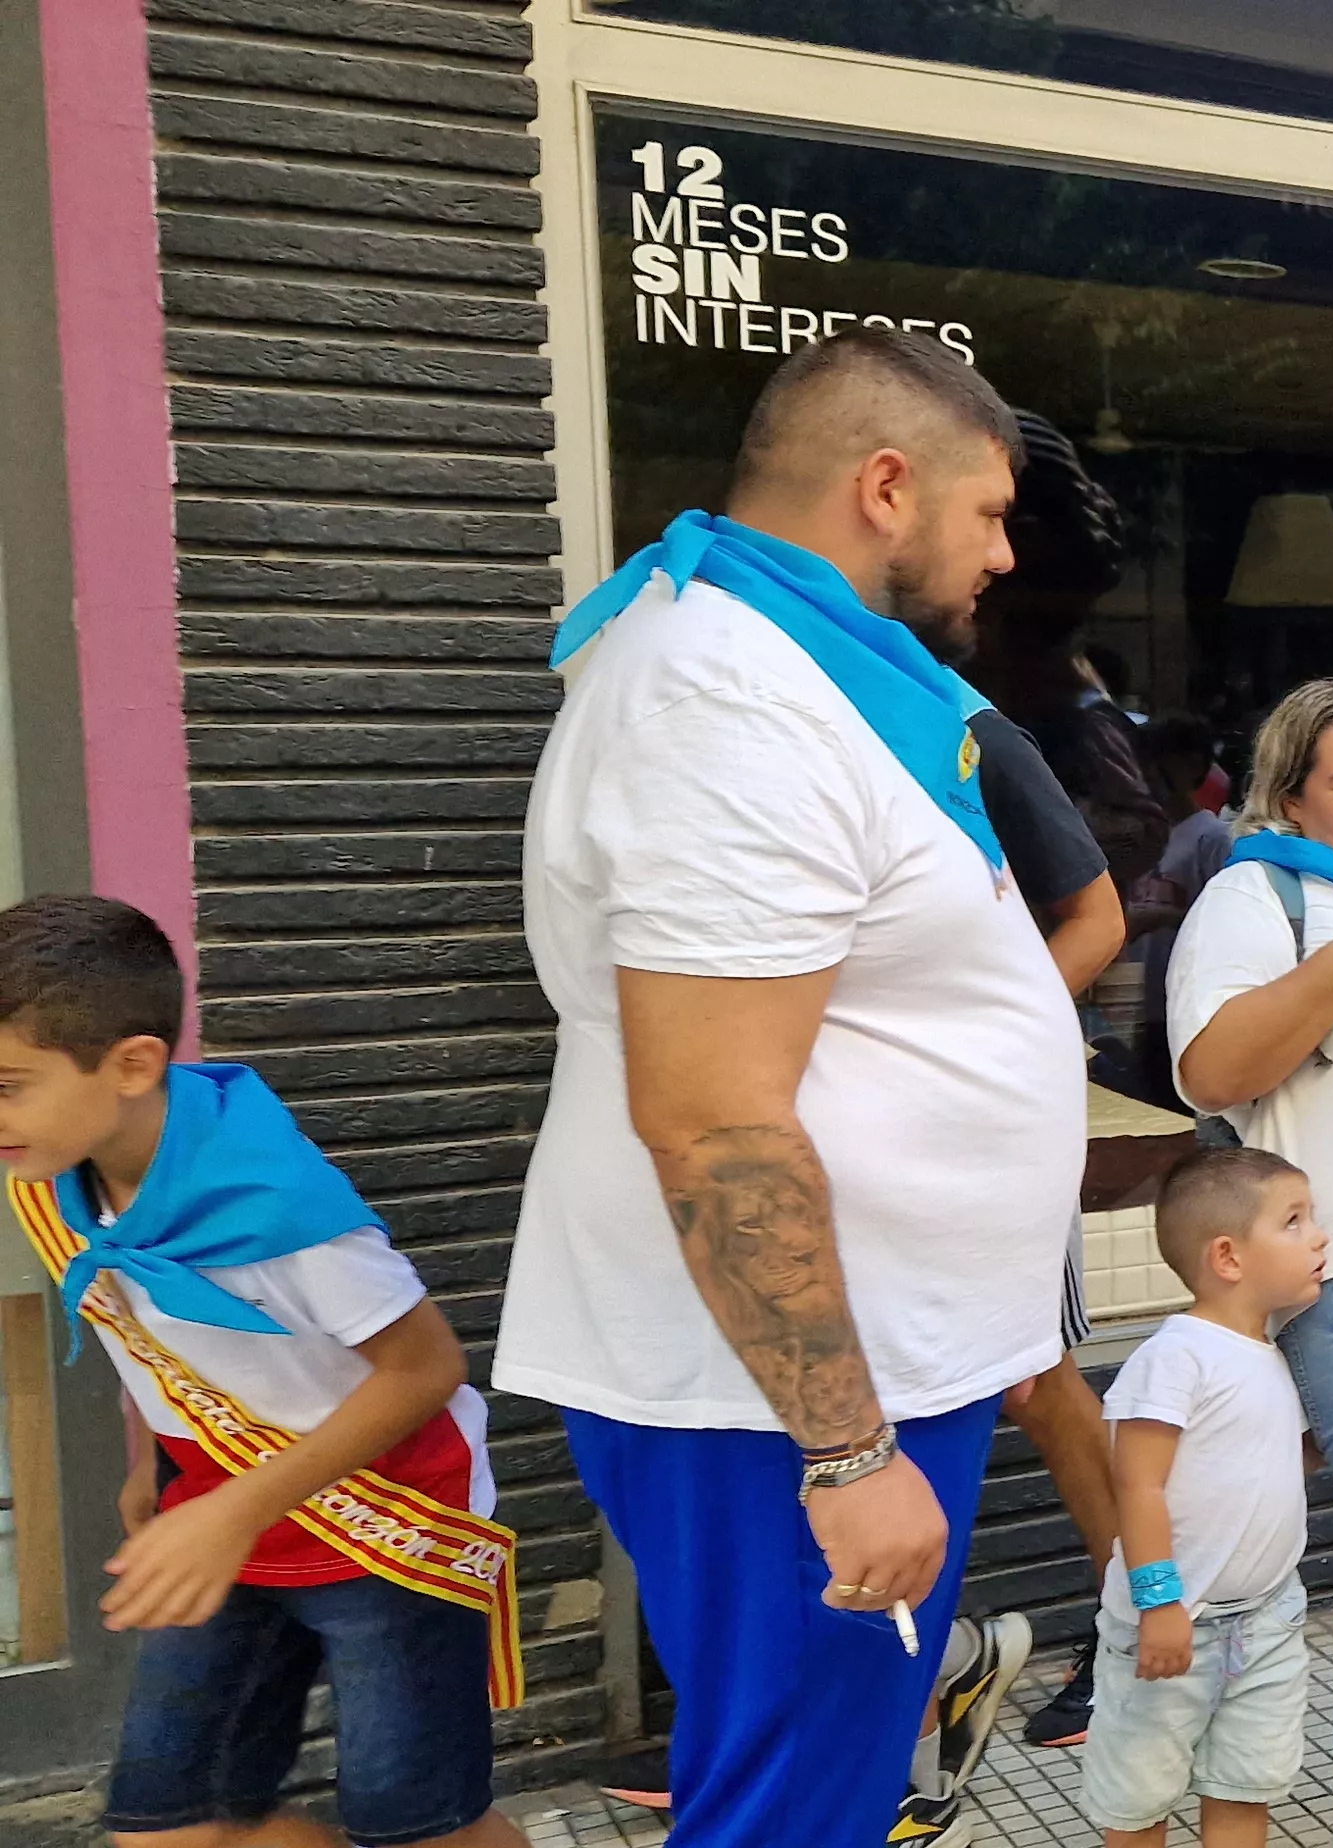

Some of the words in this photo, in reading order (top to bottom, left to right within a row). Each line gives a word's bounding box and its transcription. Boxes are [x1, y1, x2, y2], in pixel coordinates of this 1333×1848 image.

[631, 141, 724, 200] 12
[632, 192, 849, 263] MESES
[632, 243, 762, 302] SIN
[313, 1493, 438, 1560] onzón
